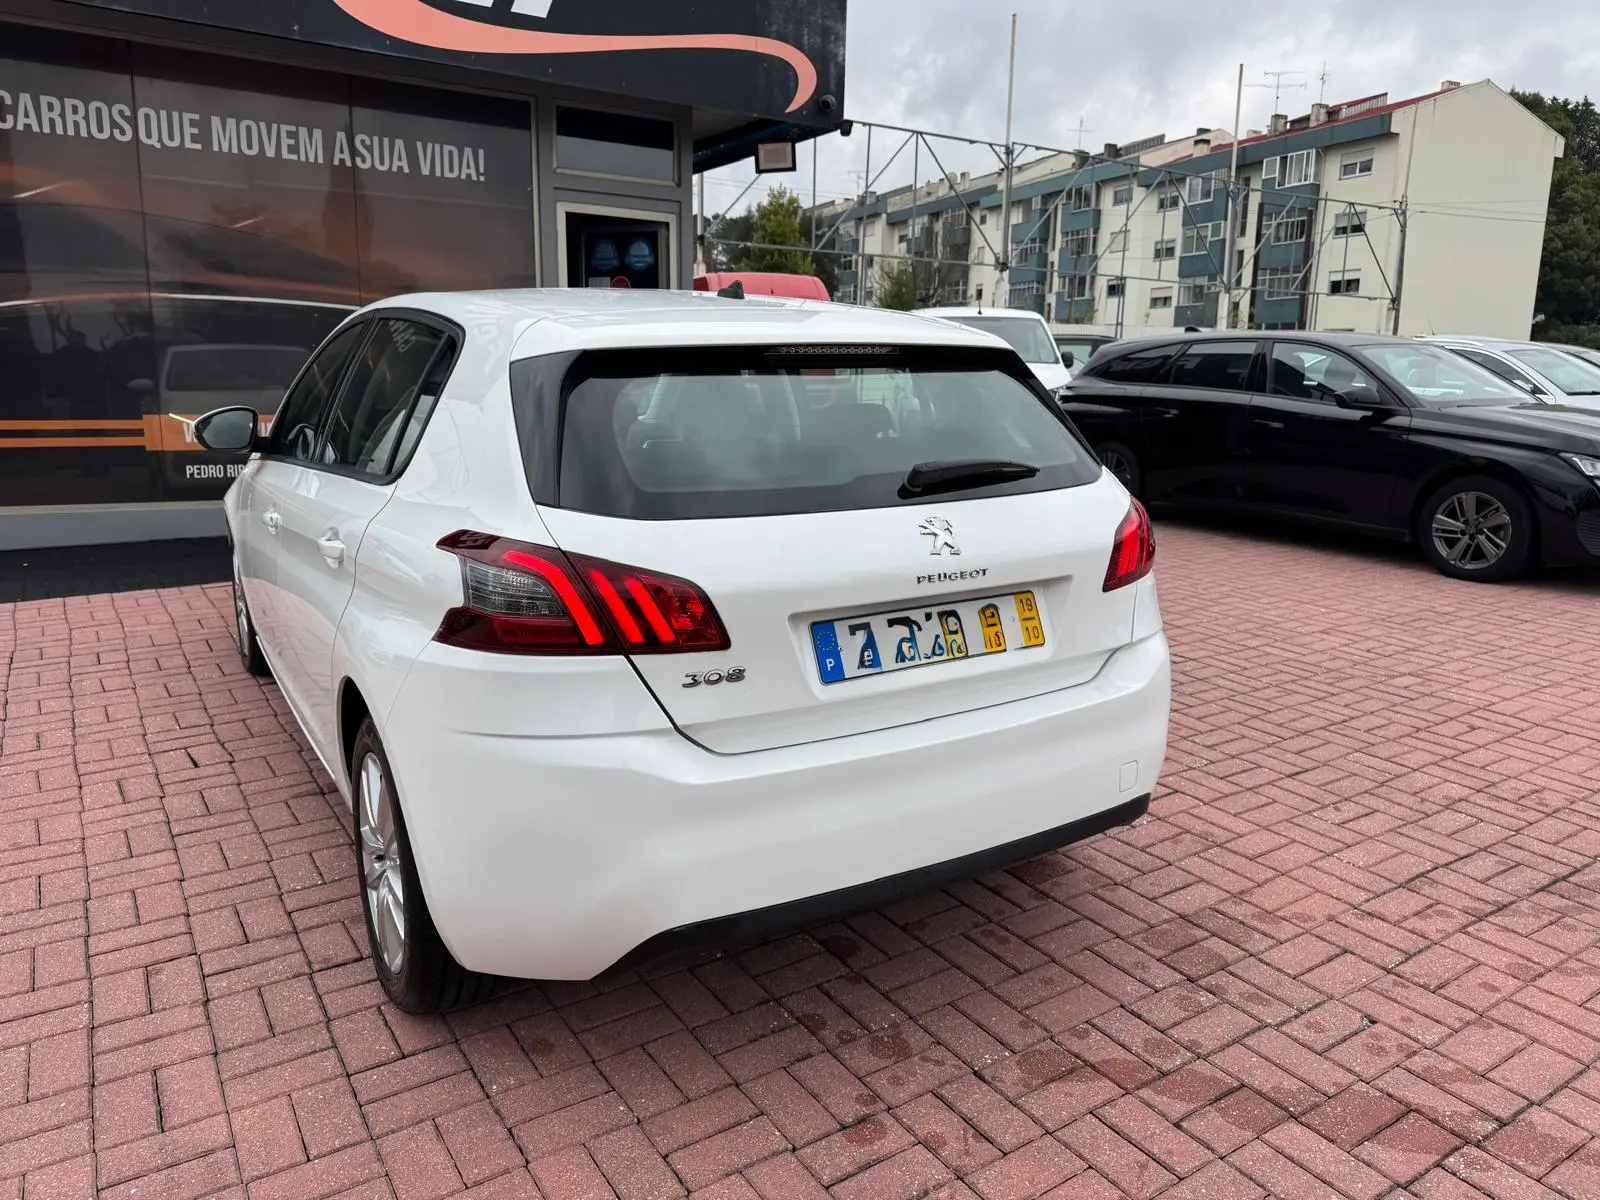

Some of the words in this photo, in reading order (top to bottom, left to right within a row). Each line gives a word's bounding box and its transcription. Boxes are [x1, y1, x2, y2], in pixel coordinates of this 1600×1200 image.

[0, 89, 133, 142] CARROS
[137, 107, 202, 150] QUE
[210, 115, 324, 164] MOVEM
[354, 134, 410, 174] SUA
[416, 140, 486, 182] VIDA!
[185, 464, 224, 479] PEDRO
[916, 568, 989, 584] PEUGEOT
[1019, 598, 1034, 612] 19
[1024, 625, 1041, 641] 10
[826, 658, 836, 671] P
[681, 665, 747, 689] 308
